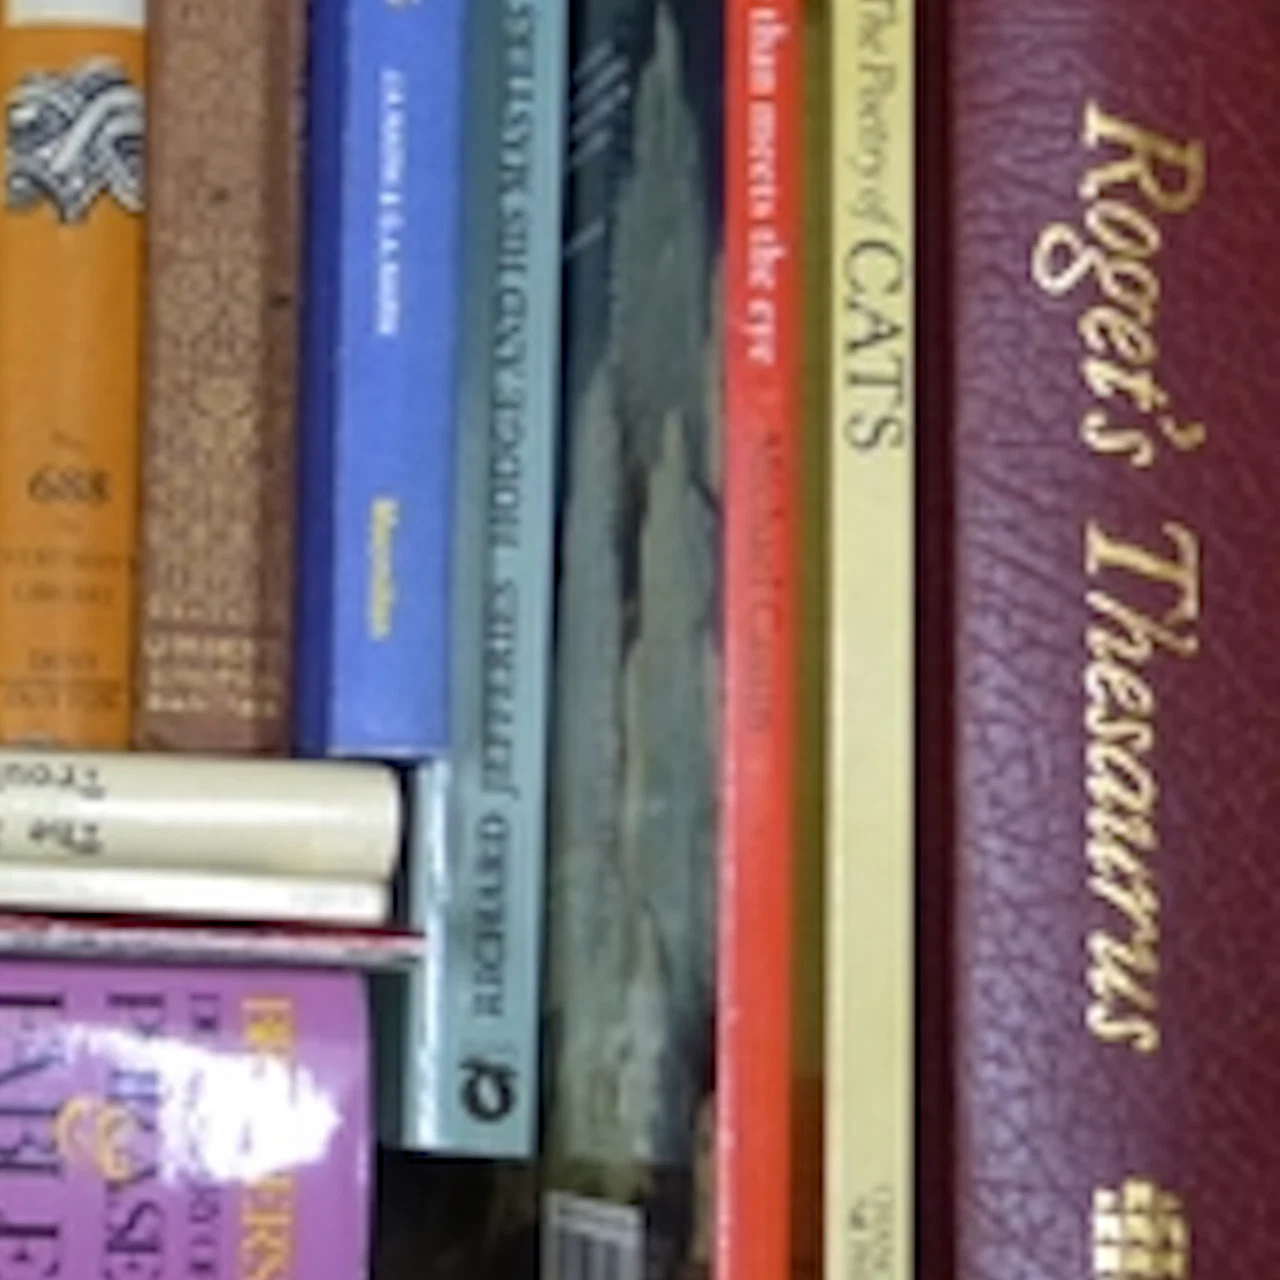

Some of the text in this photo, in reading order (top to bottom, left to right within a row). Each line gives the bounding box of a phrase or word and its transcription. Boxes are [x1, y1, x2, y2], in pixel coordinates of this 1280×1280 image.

[748, 9, 791, 93] than
[747, 100, 780, 220] meets
[842, 60, 897, 179] Poetry
[842, 186, 892, 230] of
[747, 228, 789, 292] the
[739, 299, 776, 365] eye
[841, 238, 906, 454] CATS
[472, 3, 537, 1018] RICHARD JEFFERIES HODGE AND HIS MASTERS
[1033, 97, 1207, 1055] Roget's Thesaurus
[29, 817, 103, 856] The
